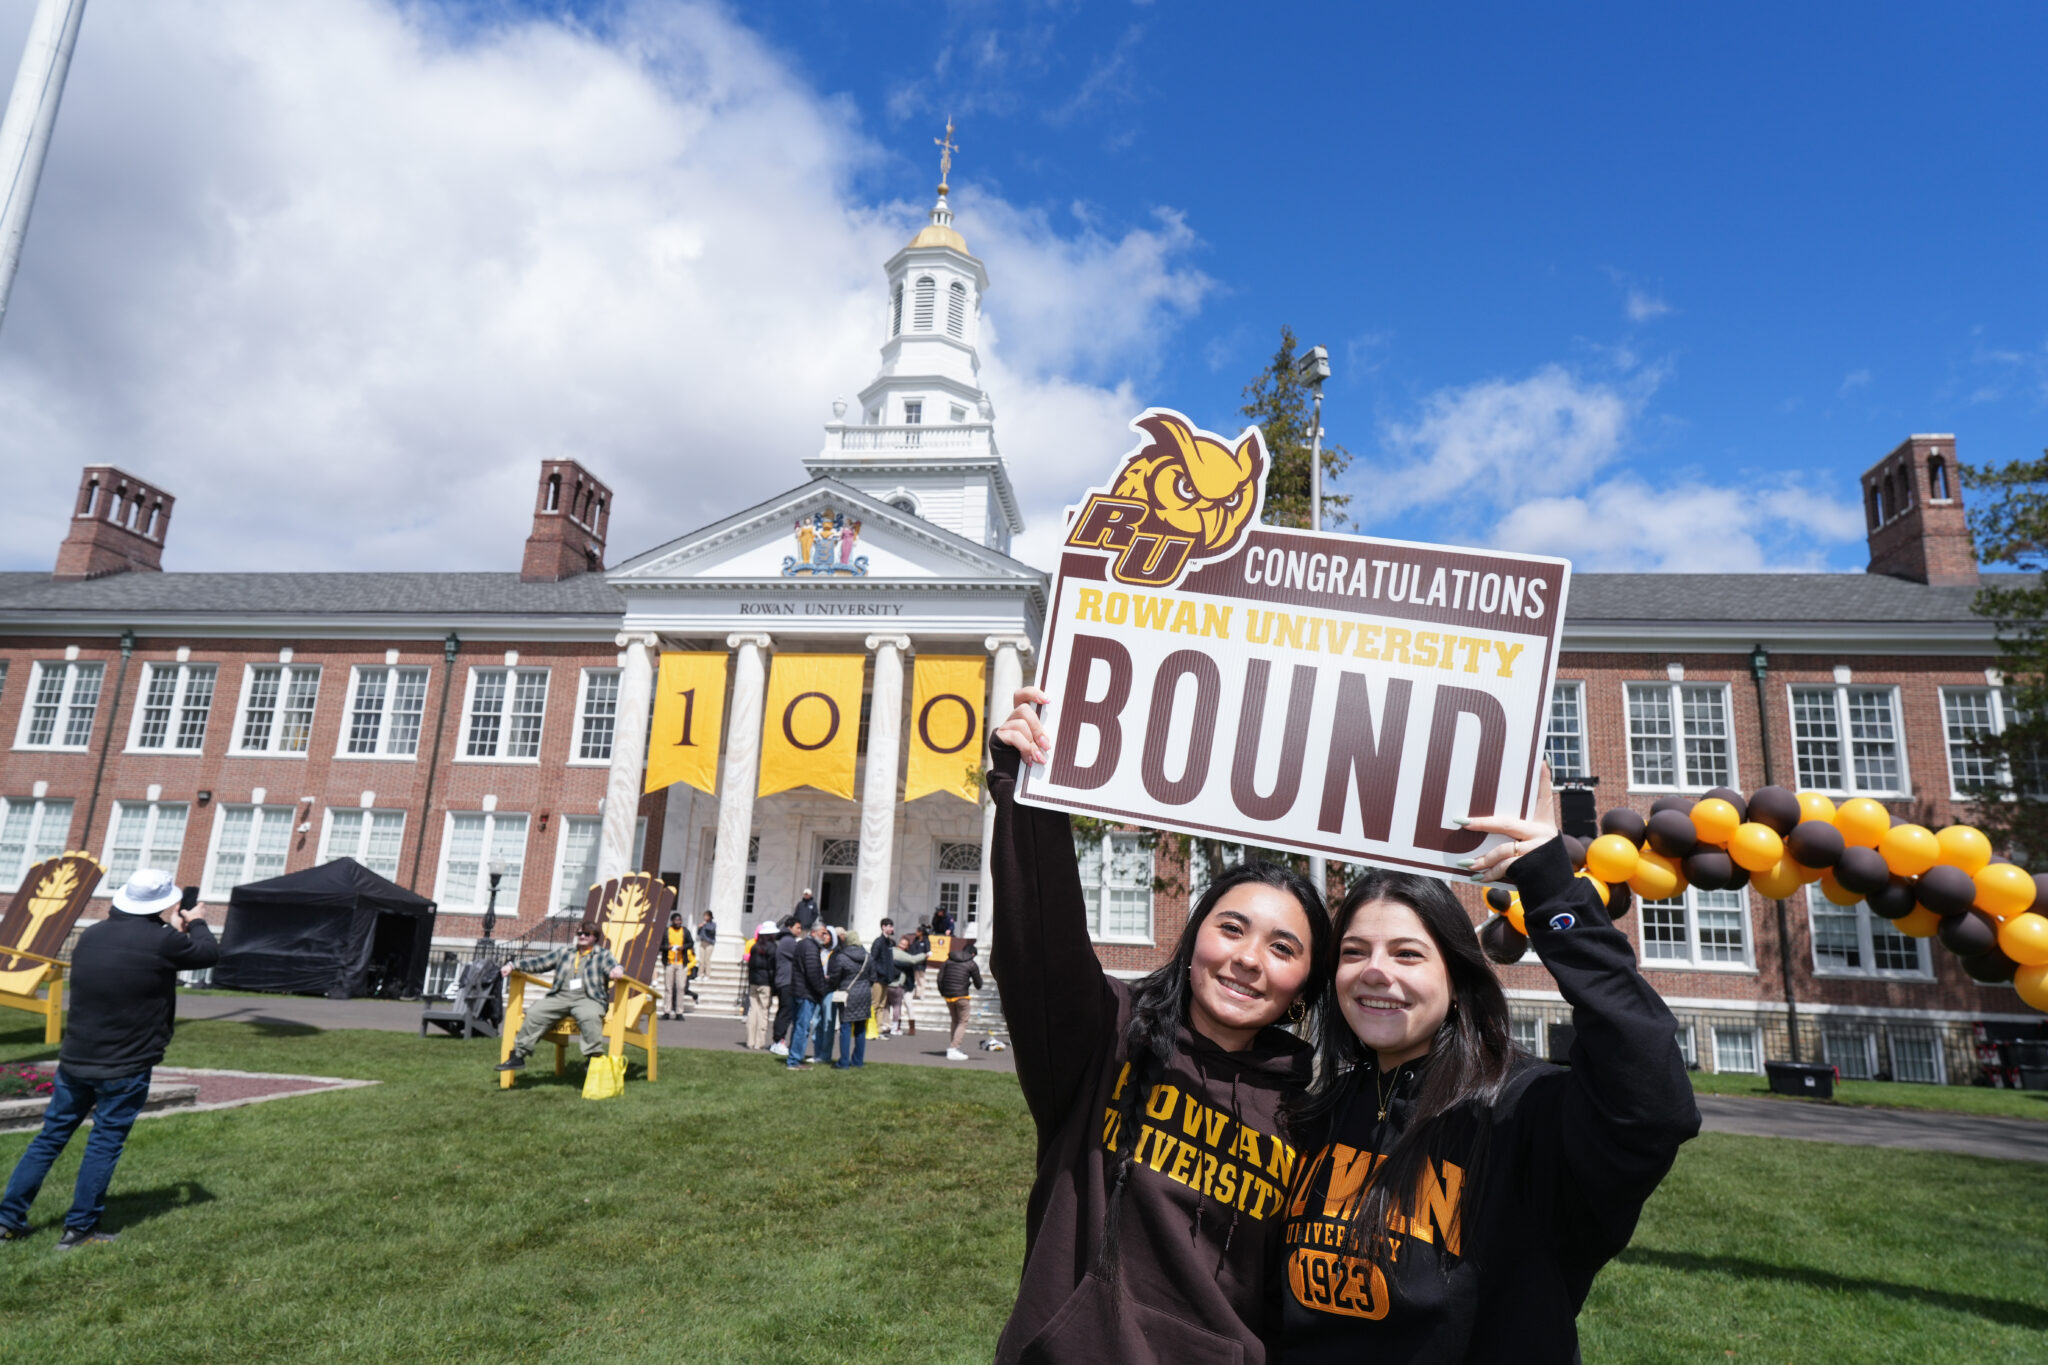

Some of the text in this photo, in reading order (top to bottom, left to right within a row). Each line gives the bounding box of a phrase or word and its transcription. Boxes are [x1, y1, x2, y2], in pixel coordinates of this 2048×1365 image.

[1064, 493, 1196, 588] RU
[740, 603, 904, 616] ROWAN UNIVERSITY
[1244, 546, 1547, 619] CONGRATULATIONS
[1075, 588, 1523, 678] ROWAN UNIVERSITY
[1049, 633, 1507, 854] BOUND
[1301, 1256, 1375, 1312] 1923
